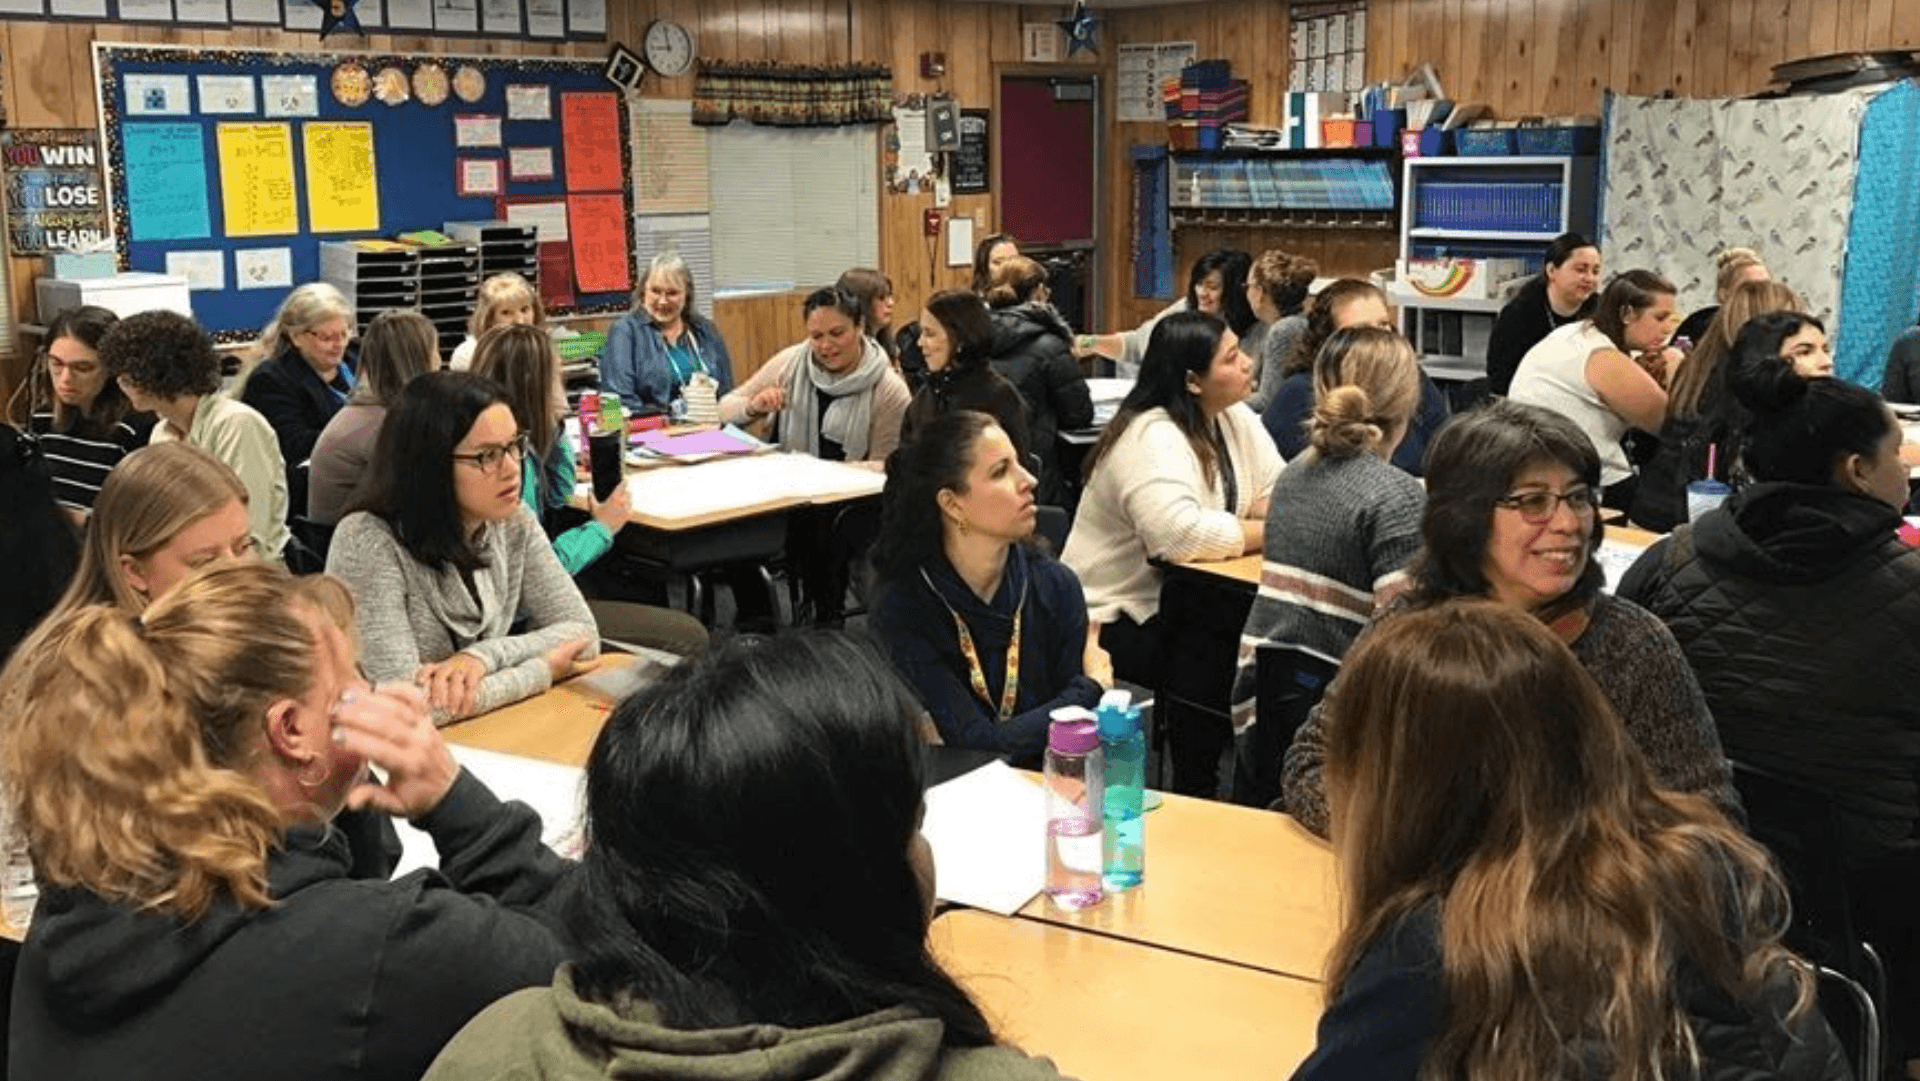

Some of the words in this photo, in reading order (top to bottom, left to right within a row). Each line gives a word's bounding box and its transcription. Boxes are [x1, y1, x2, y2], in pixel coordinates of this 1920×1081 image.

[6, 145, 40, 166] YOU
[40, 146, 95, 165] WIN
[46, 186, 99, 206] LOSE
[13, 229, 45, 250] YOU
[46, 230, 102, 248] LEARN
